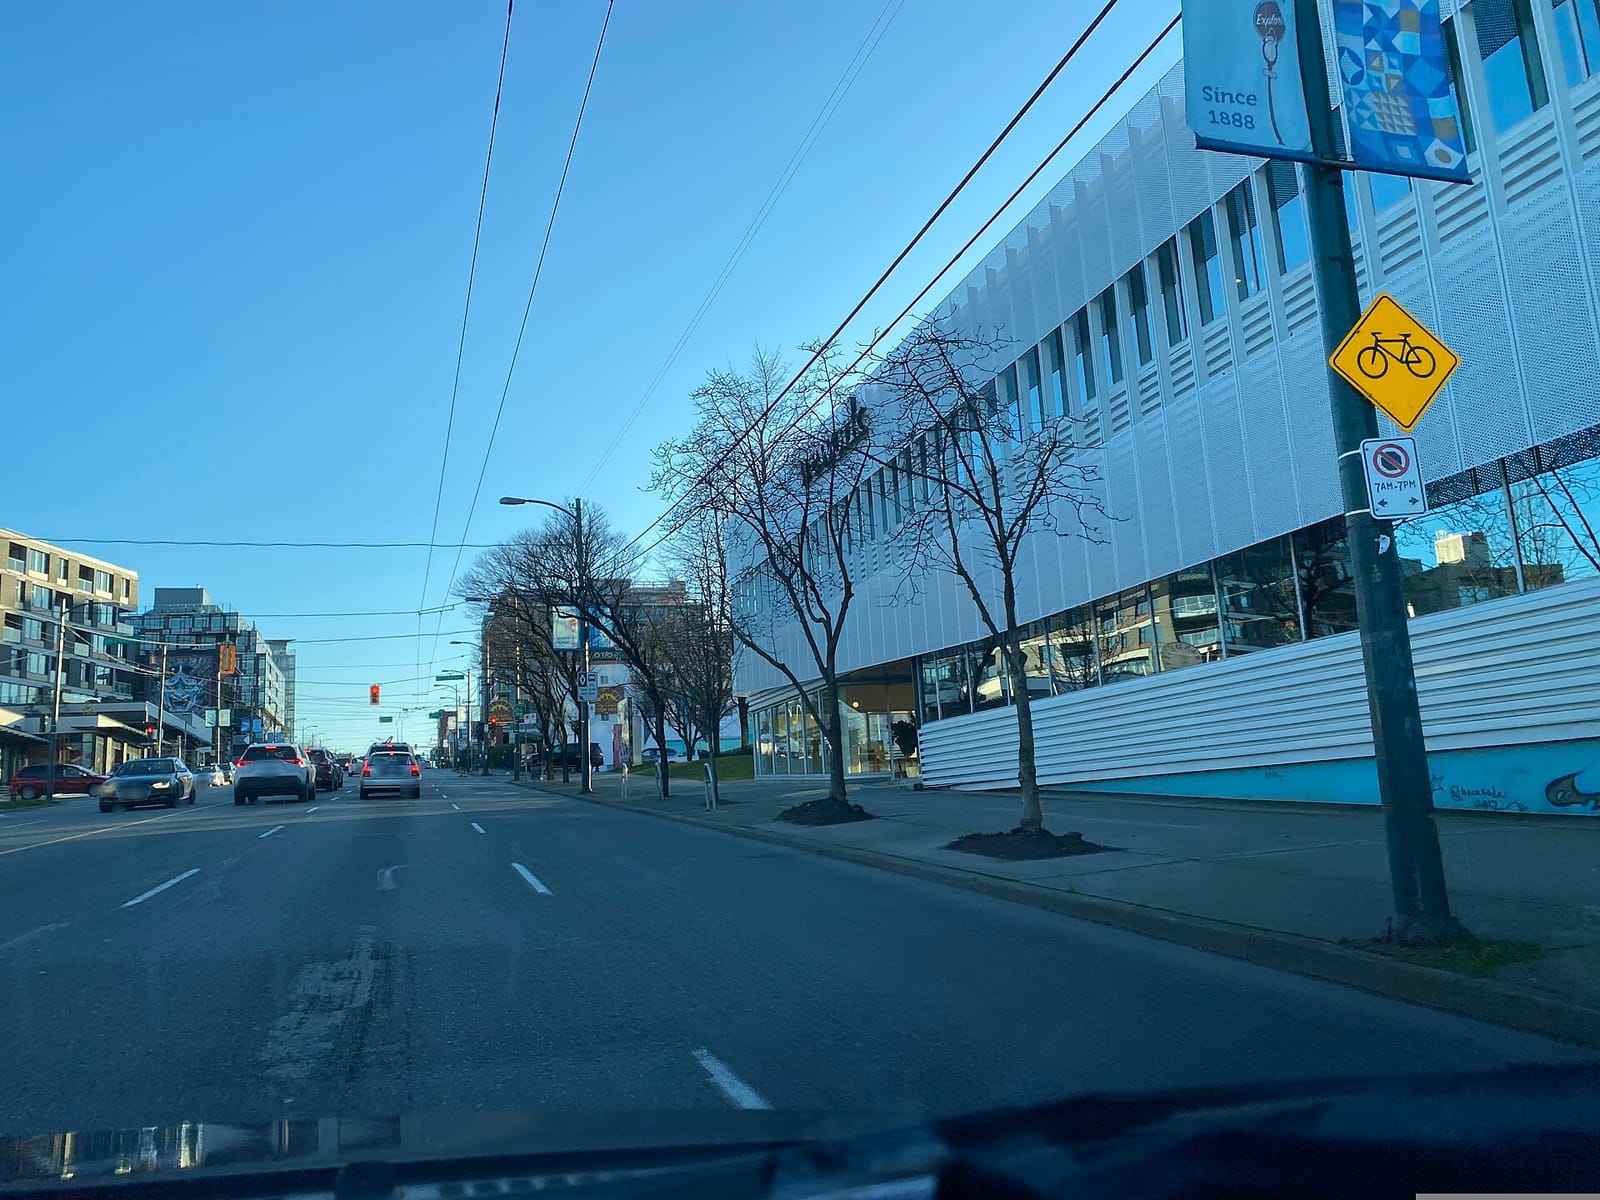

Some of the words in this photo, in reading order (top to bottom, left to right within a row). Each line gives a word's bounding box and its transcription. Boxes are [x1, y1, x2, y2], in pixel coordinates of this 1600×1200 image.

[1202, 86, 1257, 106] Since
[1209, 110, 1255, 129] 1888
[1374, 480, 1416, 493] 7AM-7PM
